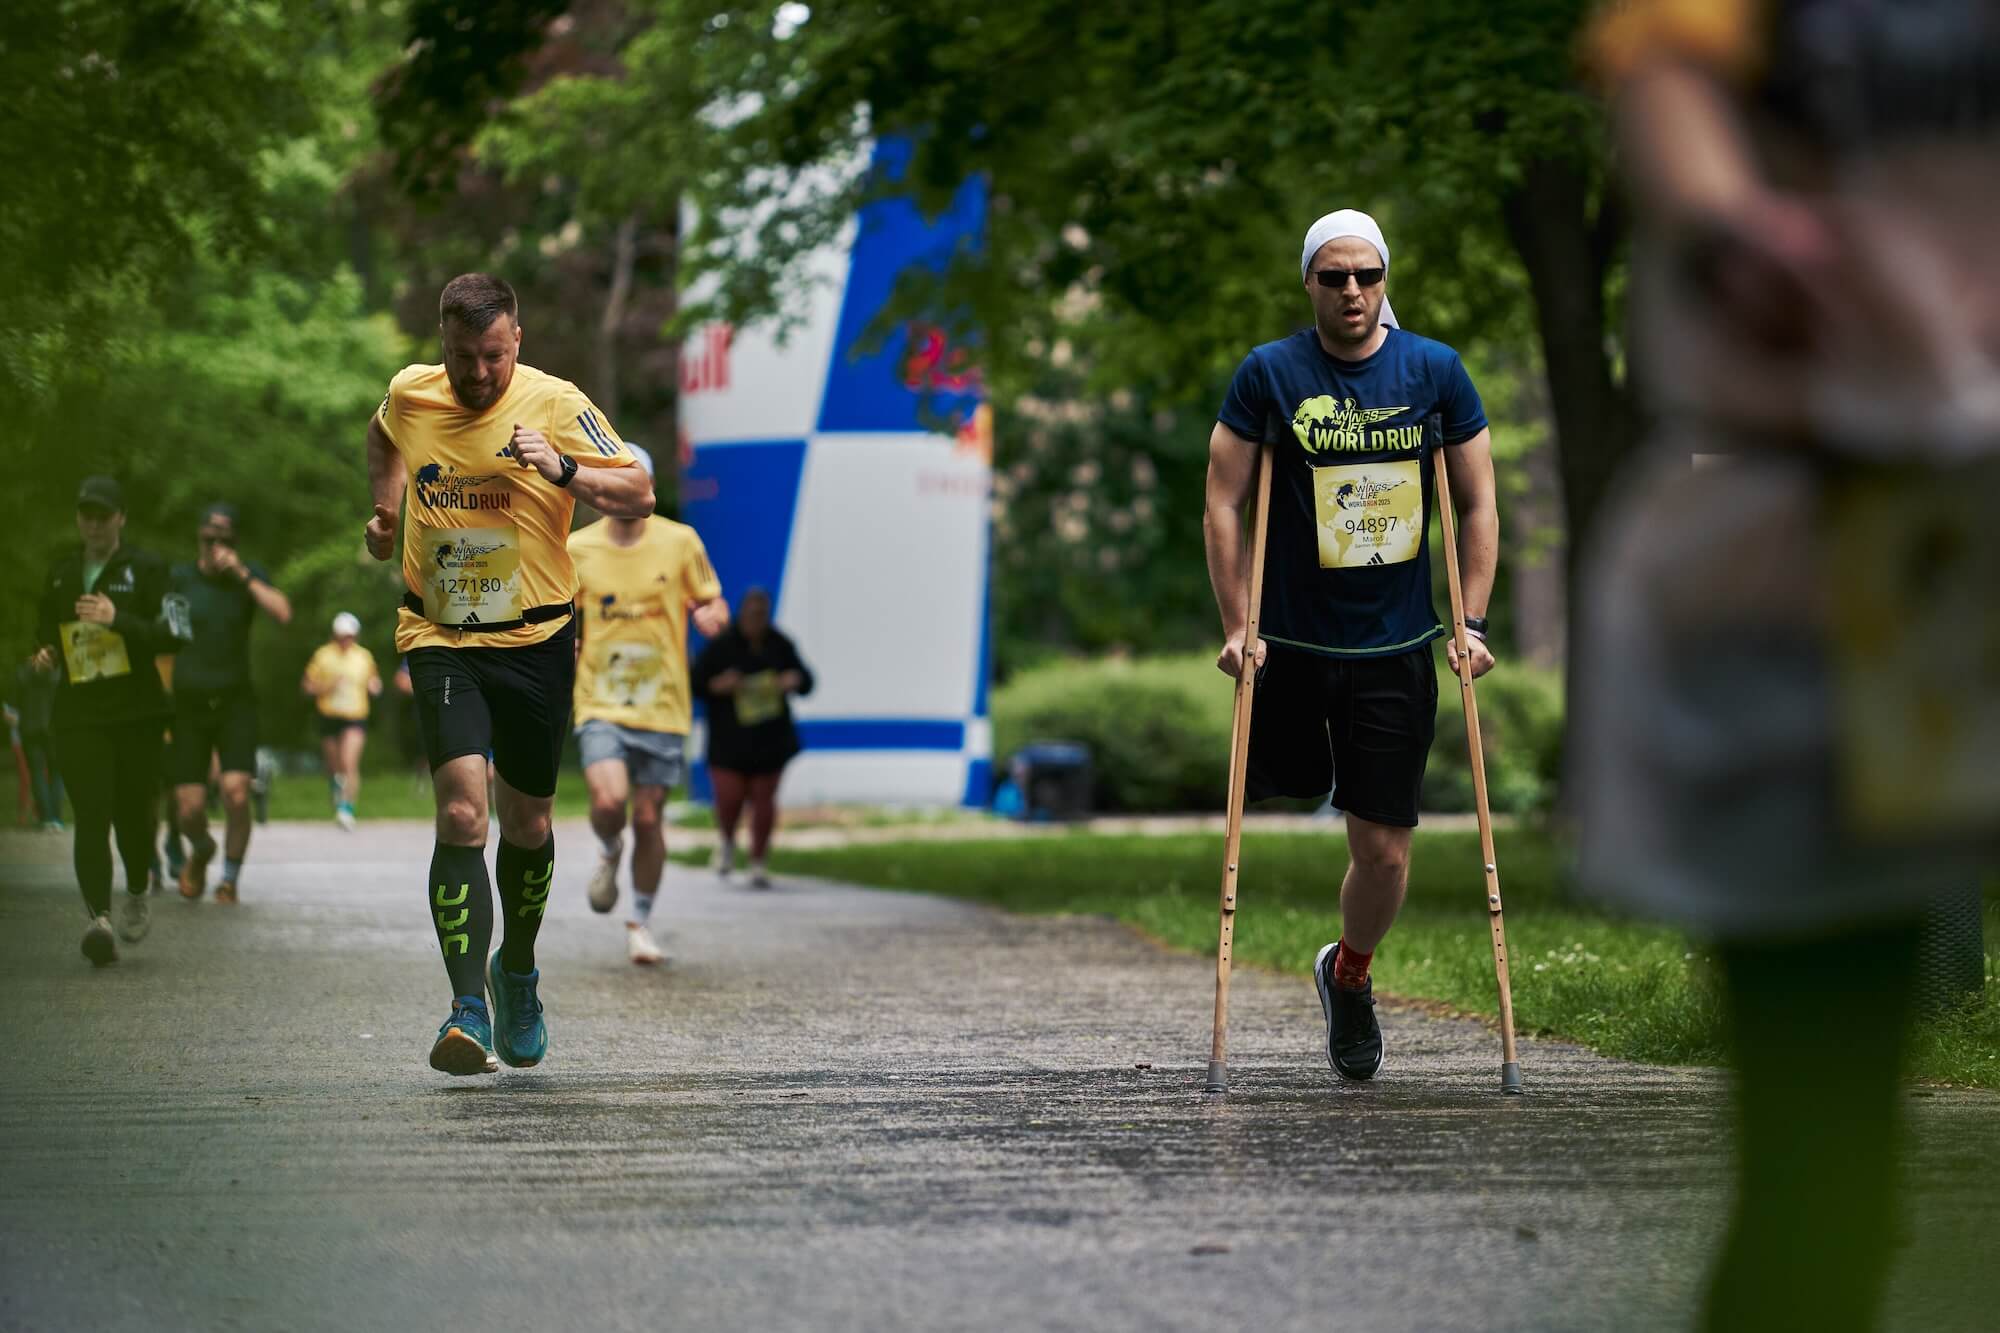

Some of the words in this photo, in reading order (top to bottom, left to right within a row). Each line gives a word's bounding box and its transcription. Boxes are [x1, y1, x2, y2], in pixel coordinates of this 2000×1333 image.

[1335, 409, 1380, 423] WINGS
[1340, 421, 1367, 433] LIFE
[439, 475, 475, 485] WINGS
[444, 484, 465, 492] LIFE
[1345, 516, 1397, 535] 94897
[440, 577, 501, 594] 127180
